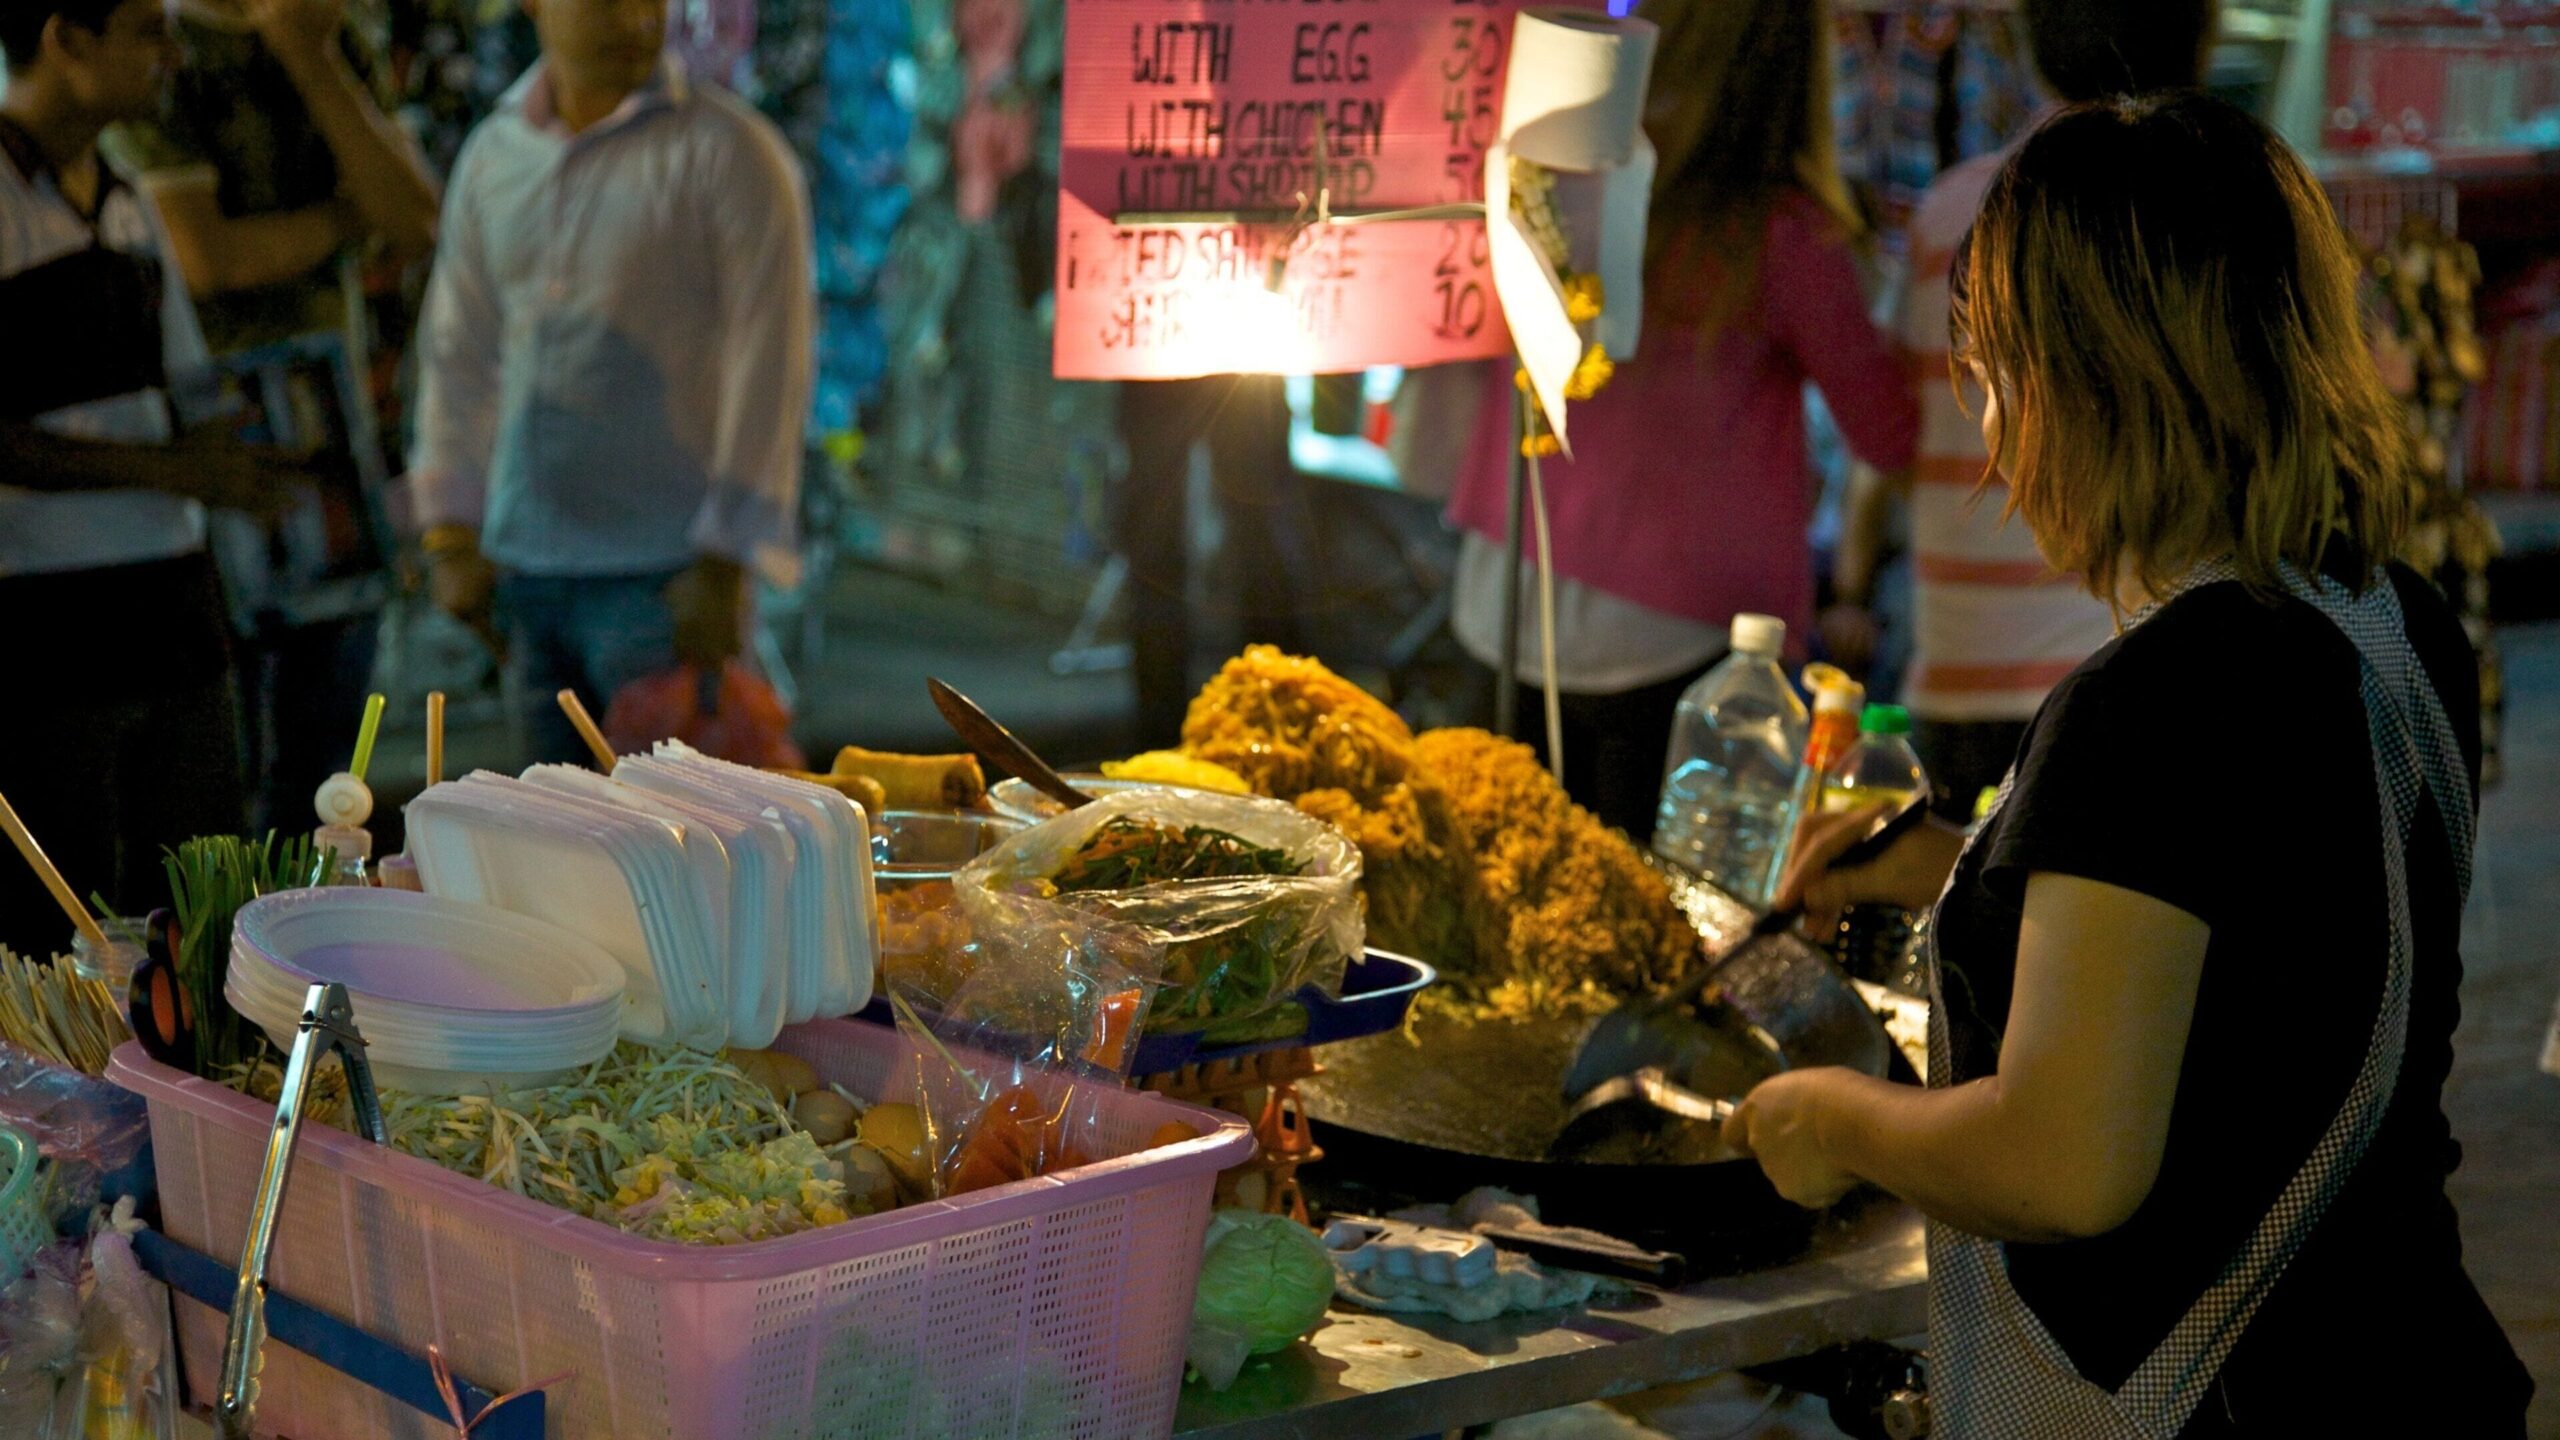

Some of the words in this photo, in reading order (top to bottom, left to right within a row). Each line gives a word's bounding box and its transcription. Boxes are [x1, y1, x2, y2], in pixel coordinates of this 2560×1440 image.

[1132, 22, 1233, 84] WITH
[1292, 22, 1371, 84] EGG
[1441, 17, 1500, 82] 30
[1127, 100, 1229, 158] WITH
[1234, 98, 1385, 158] CHICKEN
[1118, 163, 1217, 208] WITH
[1433, 279, 1486, 340] 10
